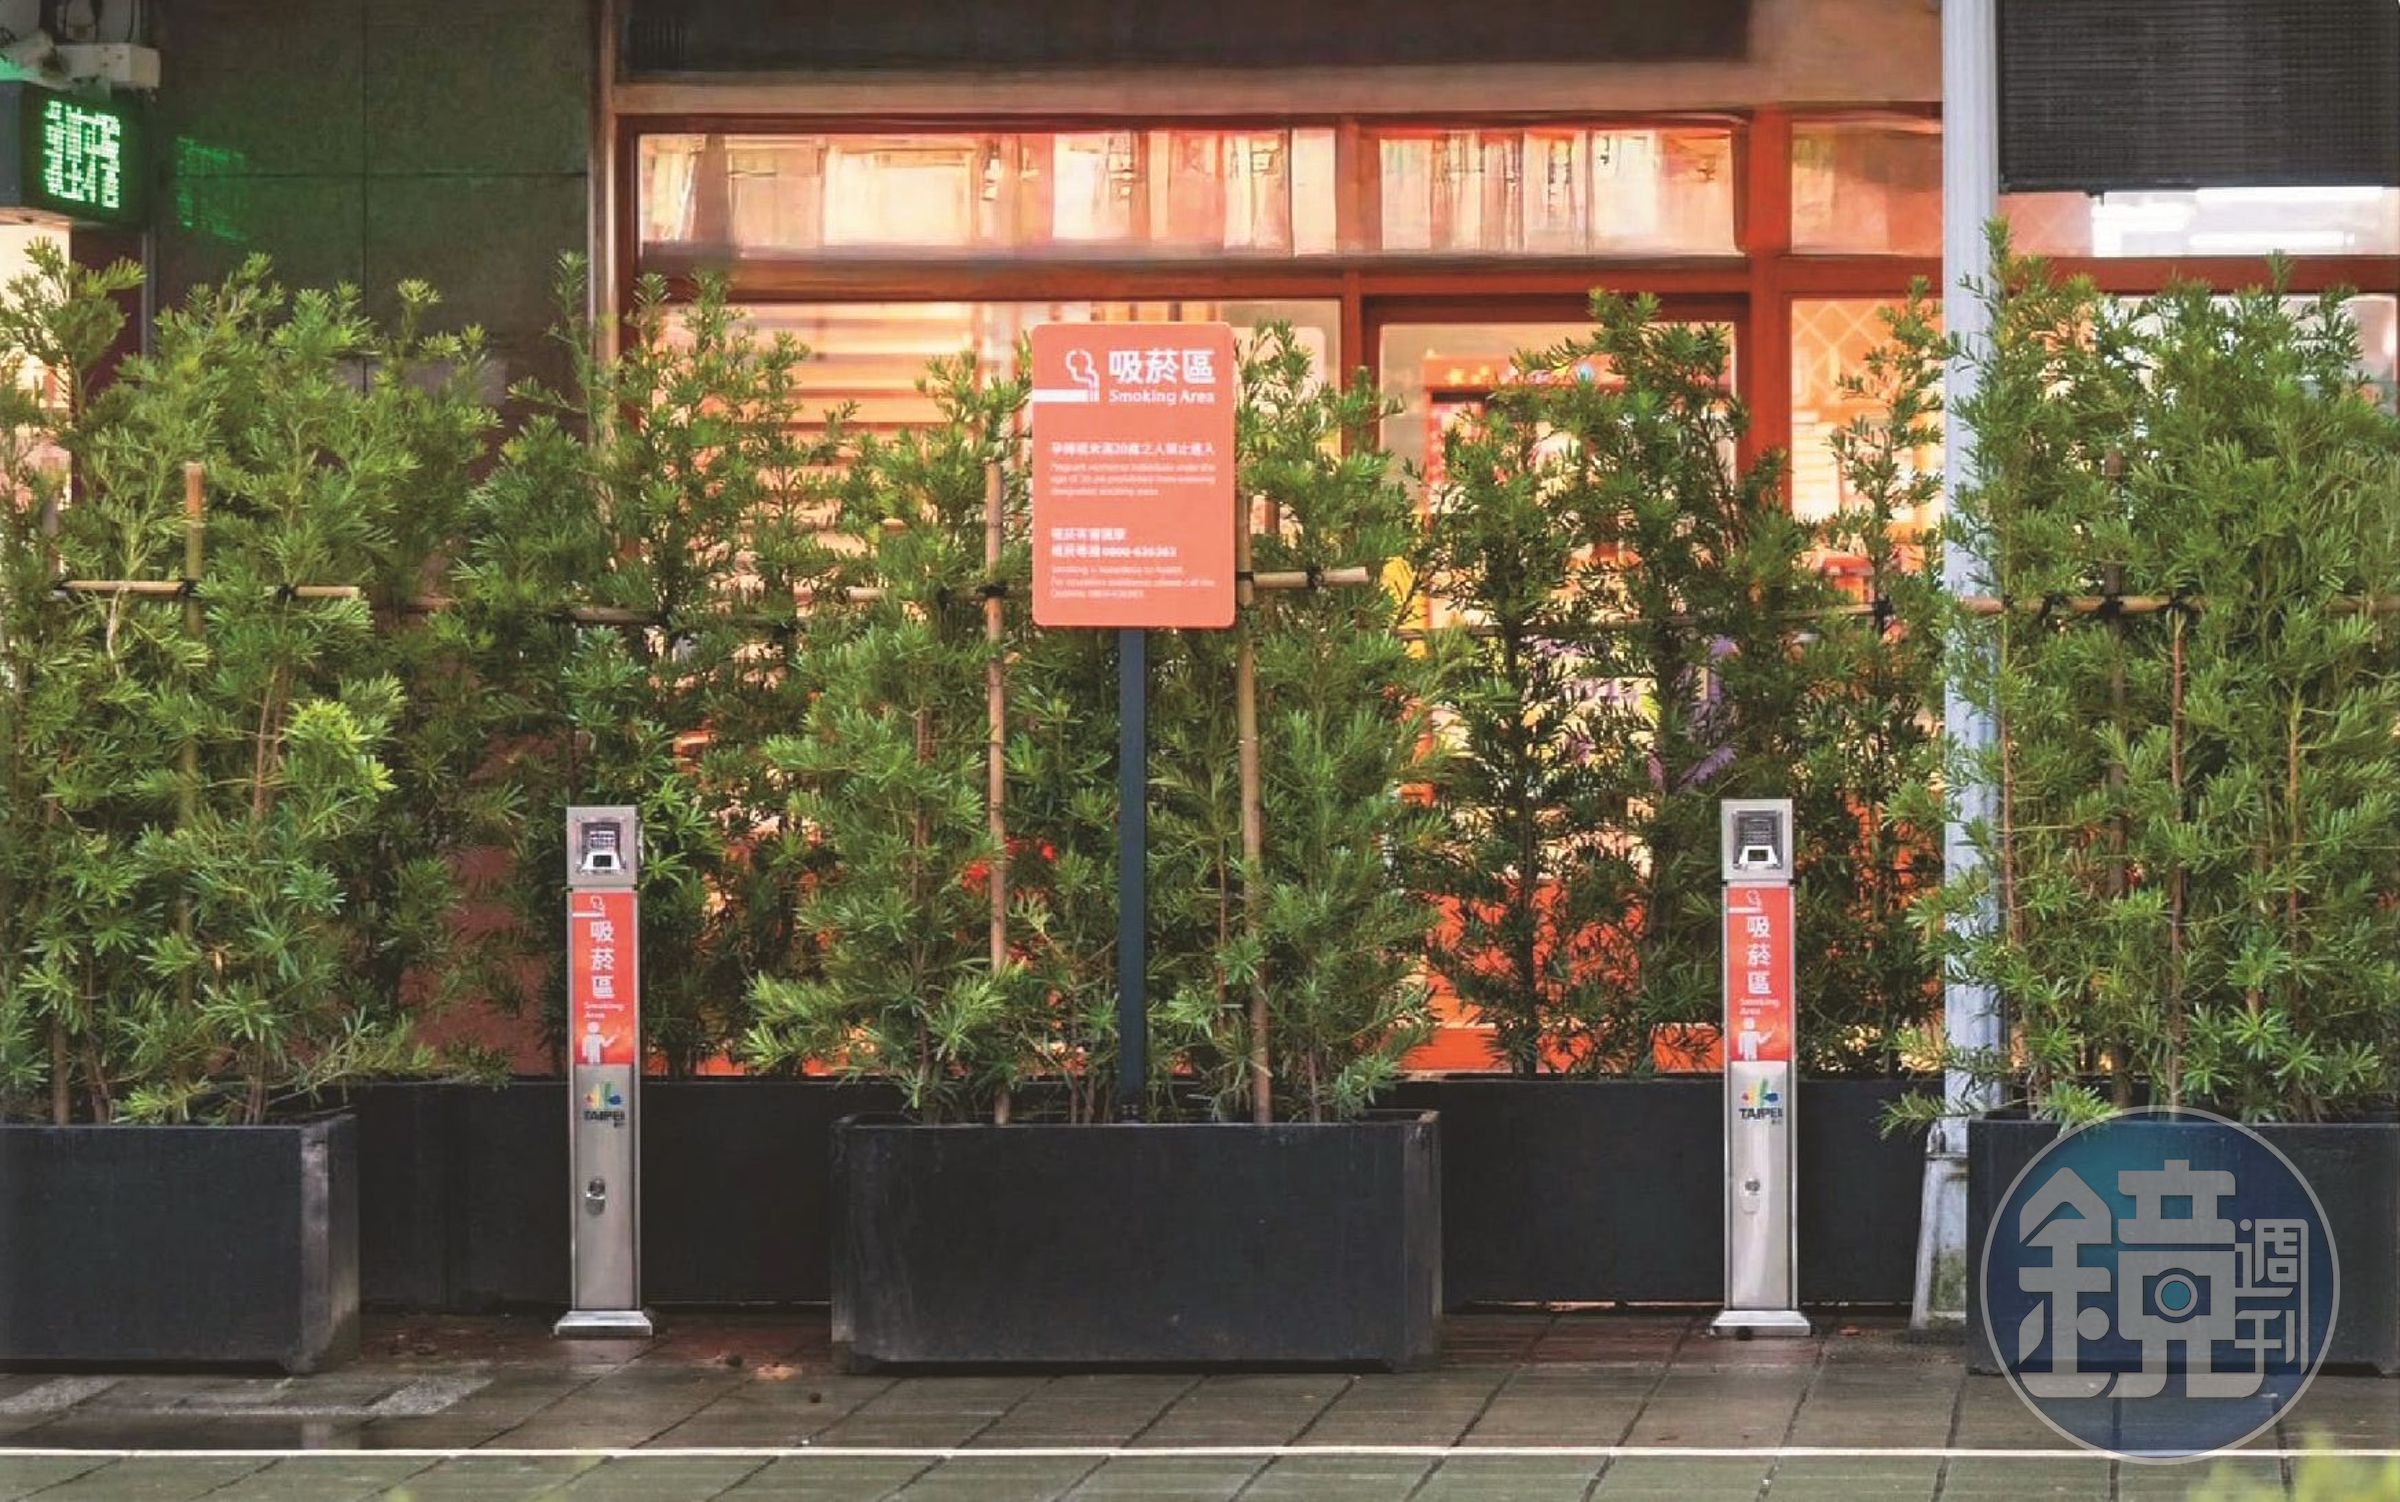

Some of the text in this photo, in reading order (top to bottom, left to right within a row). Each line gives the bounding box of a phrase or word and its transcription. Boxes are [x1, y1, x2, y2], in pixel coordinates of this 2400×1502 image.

[1108, 348, 1216, 385] 吸菸區
[1109, 390, 1215, 405] Smoking Area
[590, 920, 615, 998] 吸菸區
[1747, 915, 1772, 995] 吸菸區
[1738, 1107, 1783, 1119] TAIPEI
